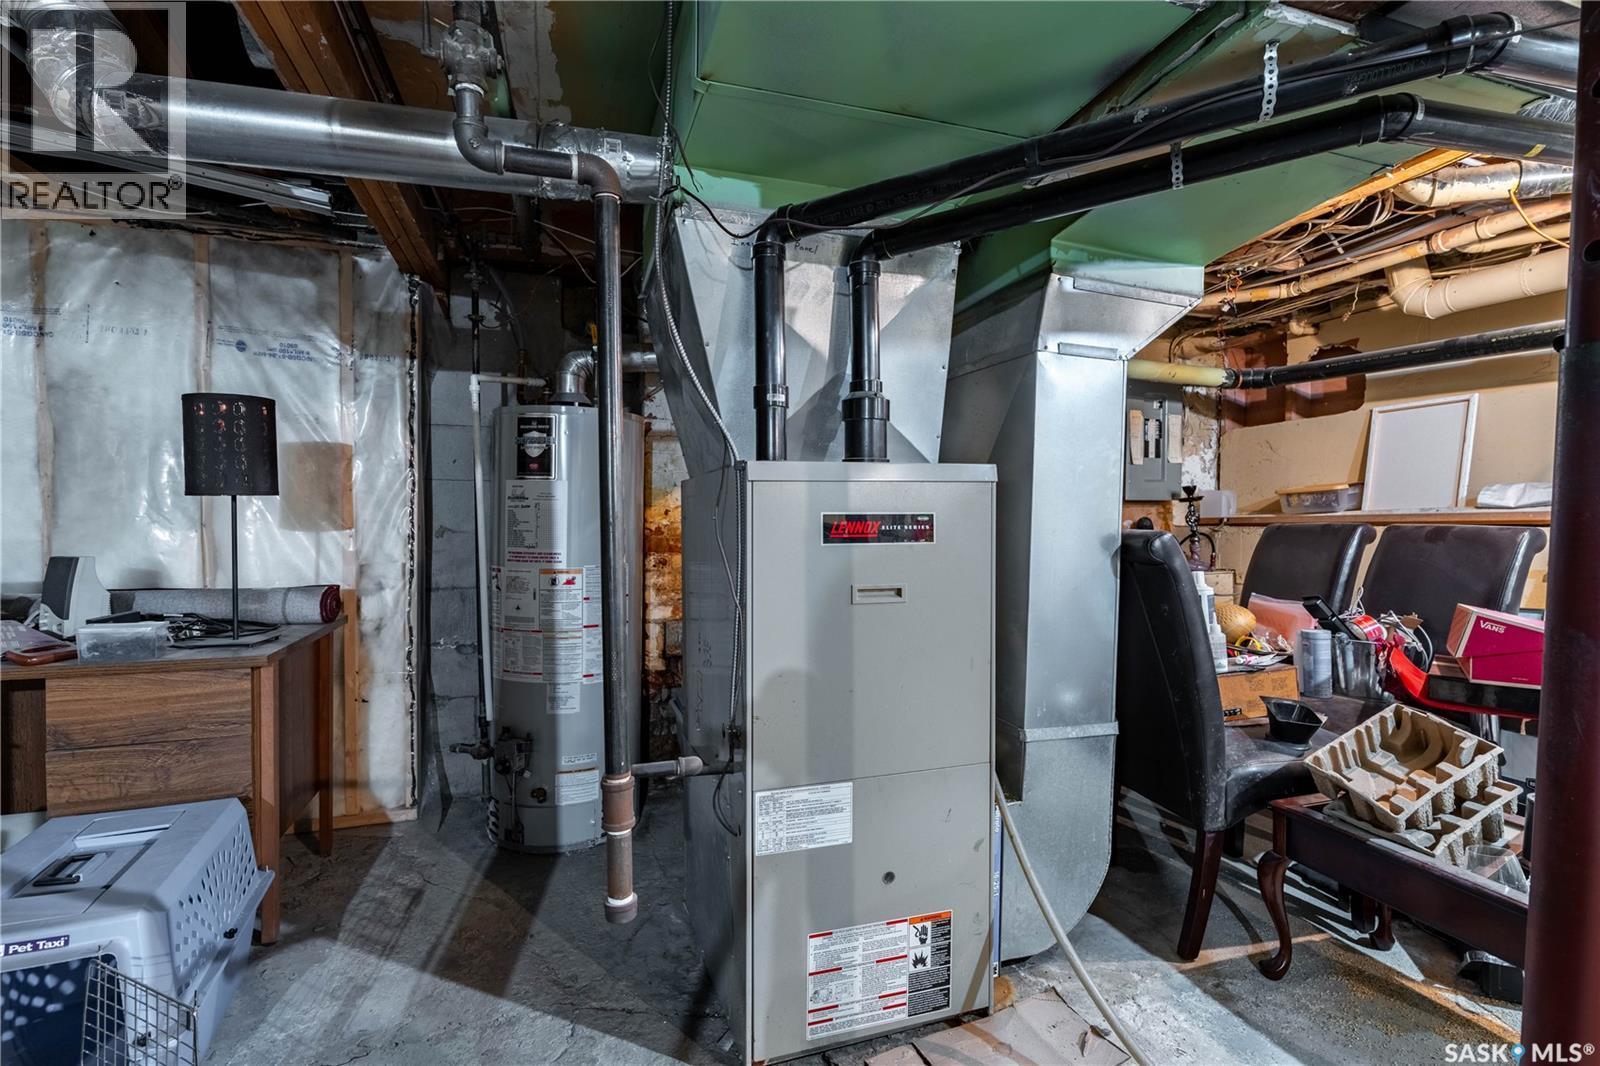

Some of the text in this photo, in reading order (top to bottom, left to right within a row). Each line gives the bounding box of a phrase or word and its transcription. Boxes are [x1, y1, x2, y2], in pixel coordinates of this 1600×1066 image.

[794, 241, 819, 255] Panel
[831, 519, 881, 536] LENNOX
[1480, 619, 1507, 634] VANS
[8, 937, 66, 954] Pet Taxi
